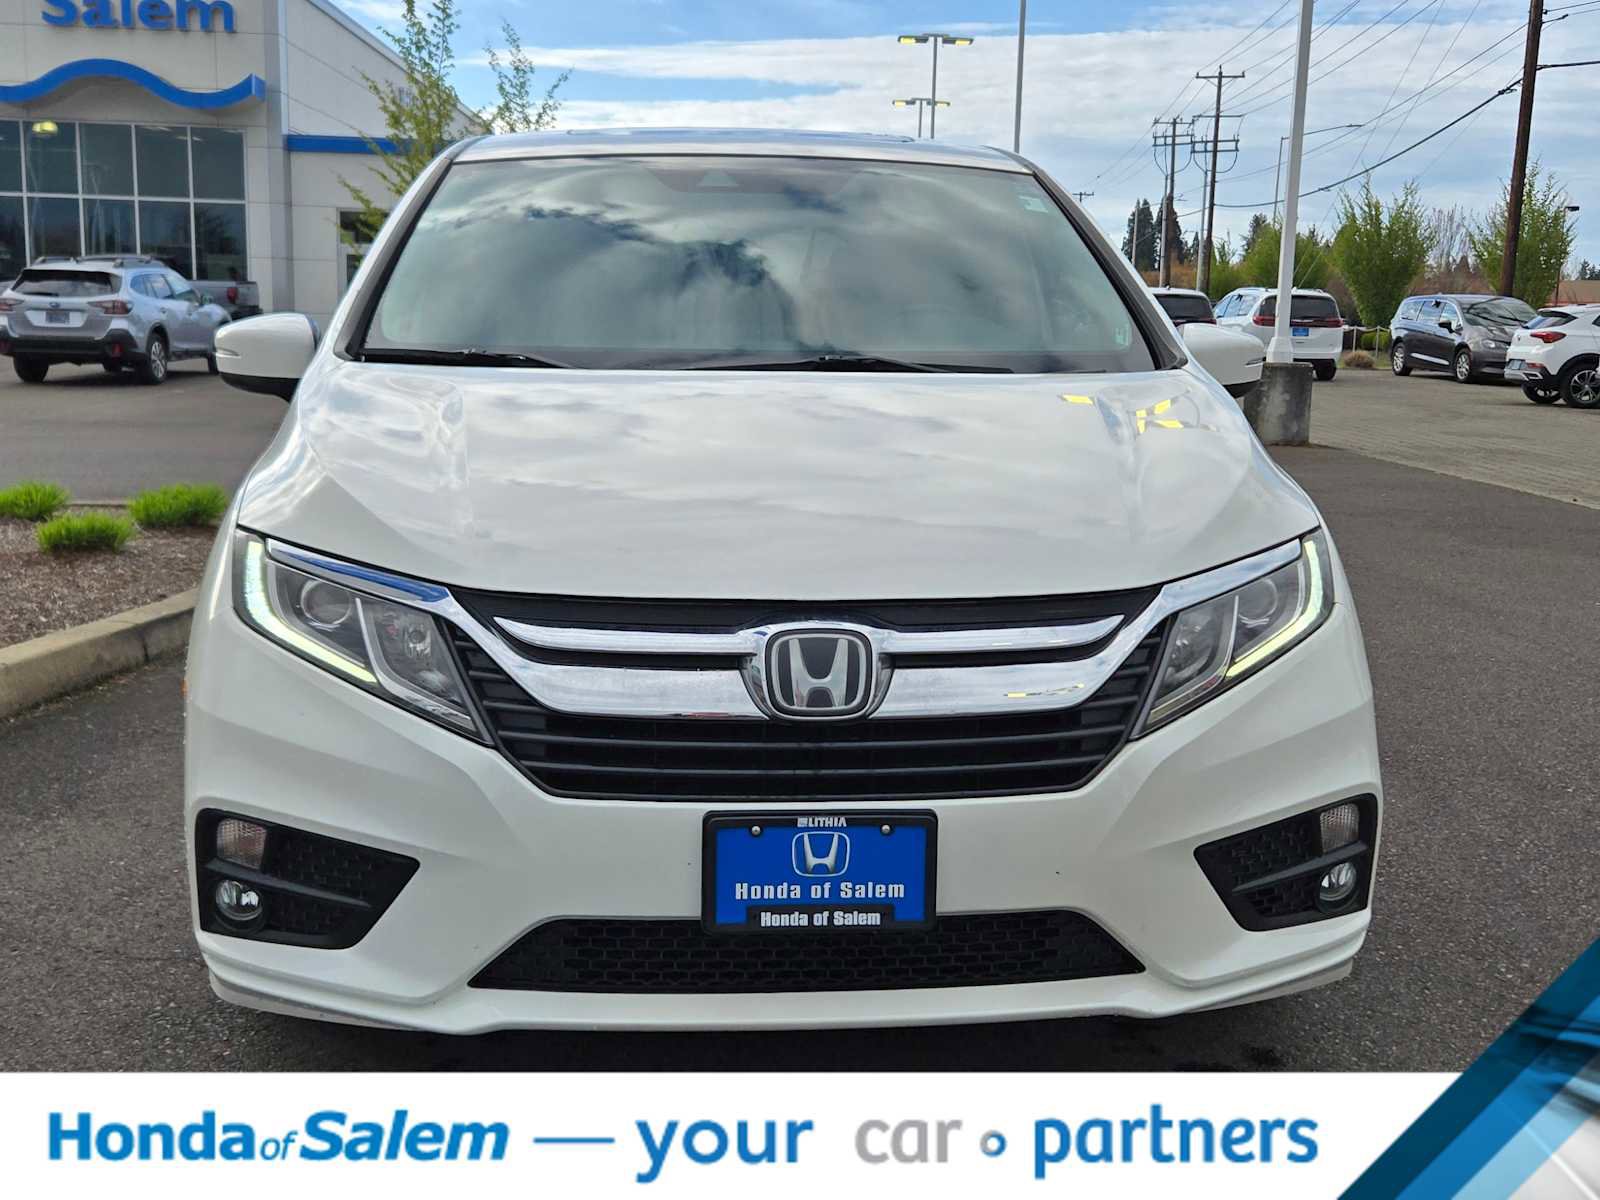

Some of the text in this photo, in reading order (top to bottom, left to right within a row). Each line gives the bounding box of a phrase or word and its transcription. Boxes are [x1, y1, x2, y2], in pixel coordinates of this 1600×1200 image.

[42, 0, 235, 33] Salem
[808, 816, 847, 828] LITHIA
[735, 881, 905, 900] Honda of Salem
[760, 911, 881, 927] Honda of Salem
